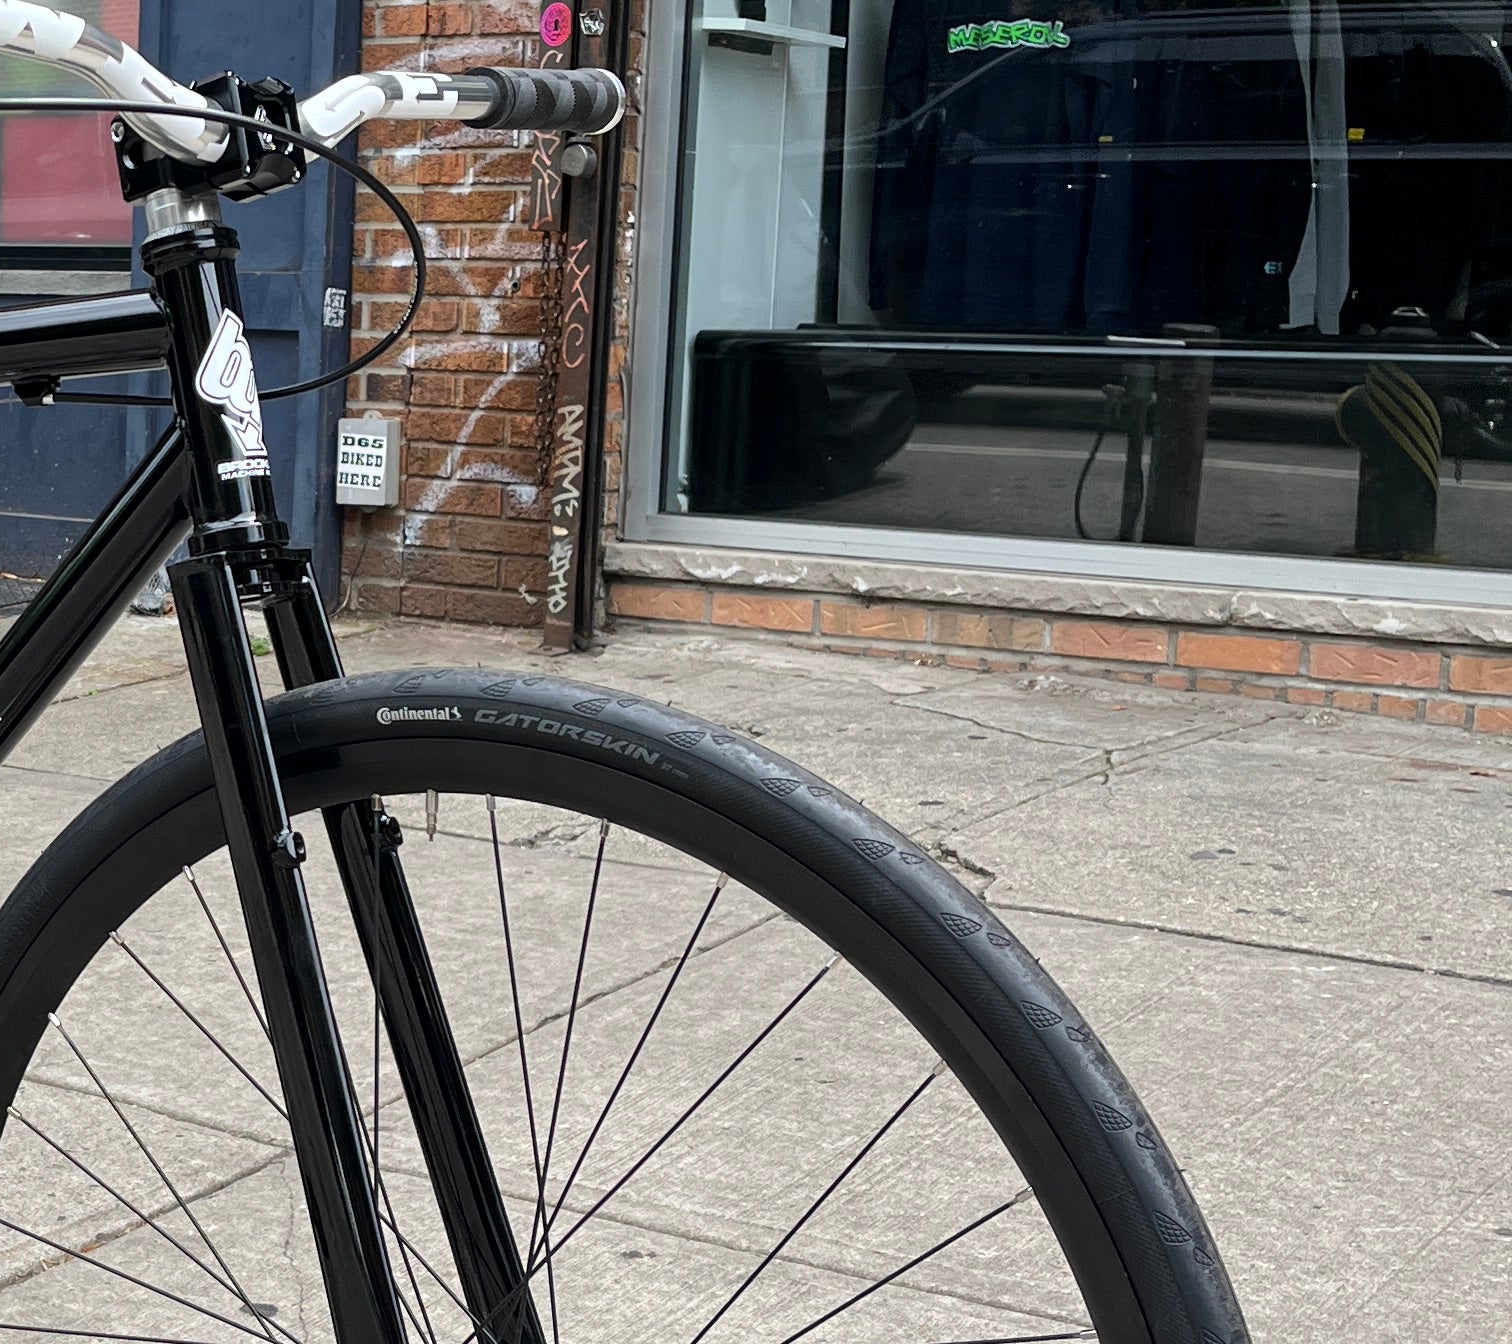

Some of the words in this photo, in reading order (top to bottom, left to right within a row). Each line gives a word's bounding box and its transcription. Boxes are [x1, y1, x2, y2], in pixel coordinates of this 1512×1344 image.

[341, 452, 383, 467] BIKED
[338, 472, 381, 488] HERE
[376, 706, 450, 725] Continental
[474, 709, 661, 765] GATORSKIN
